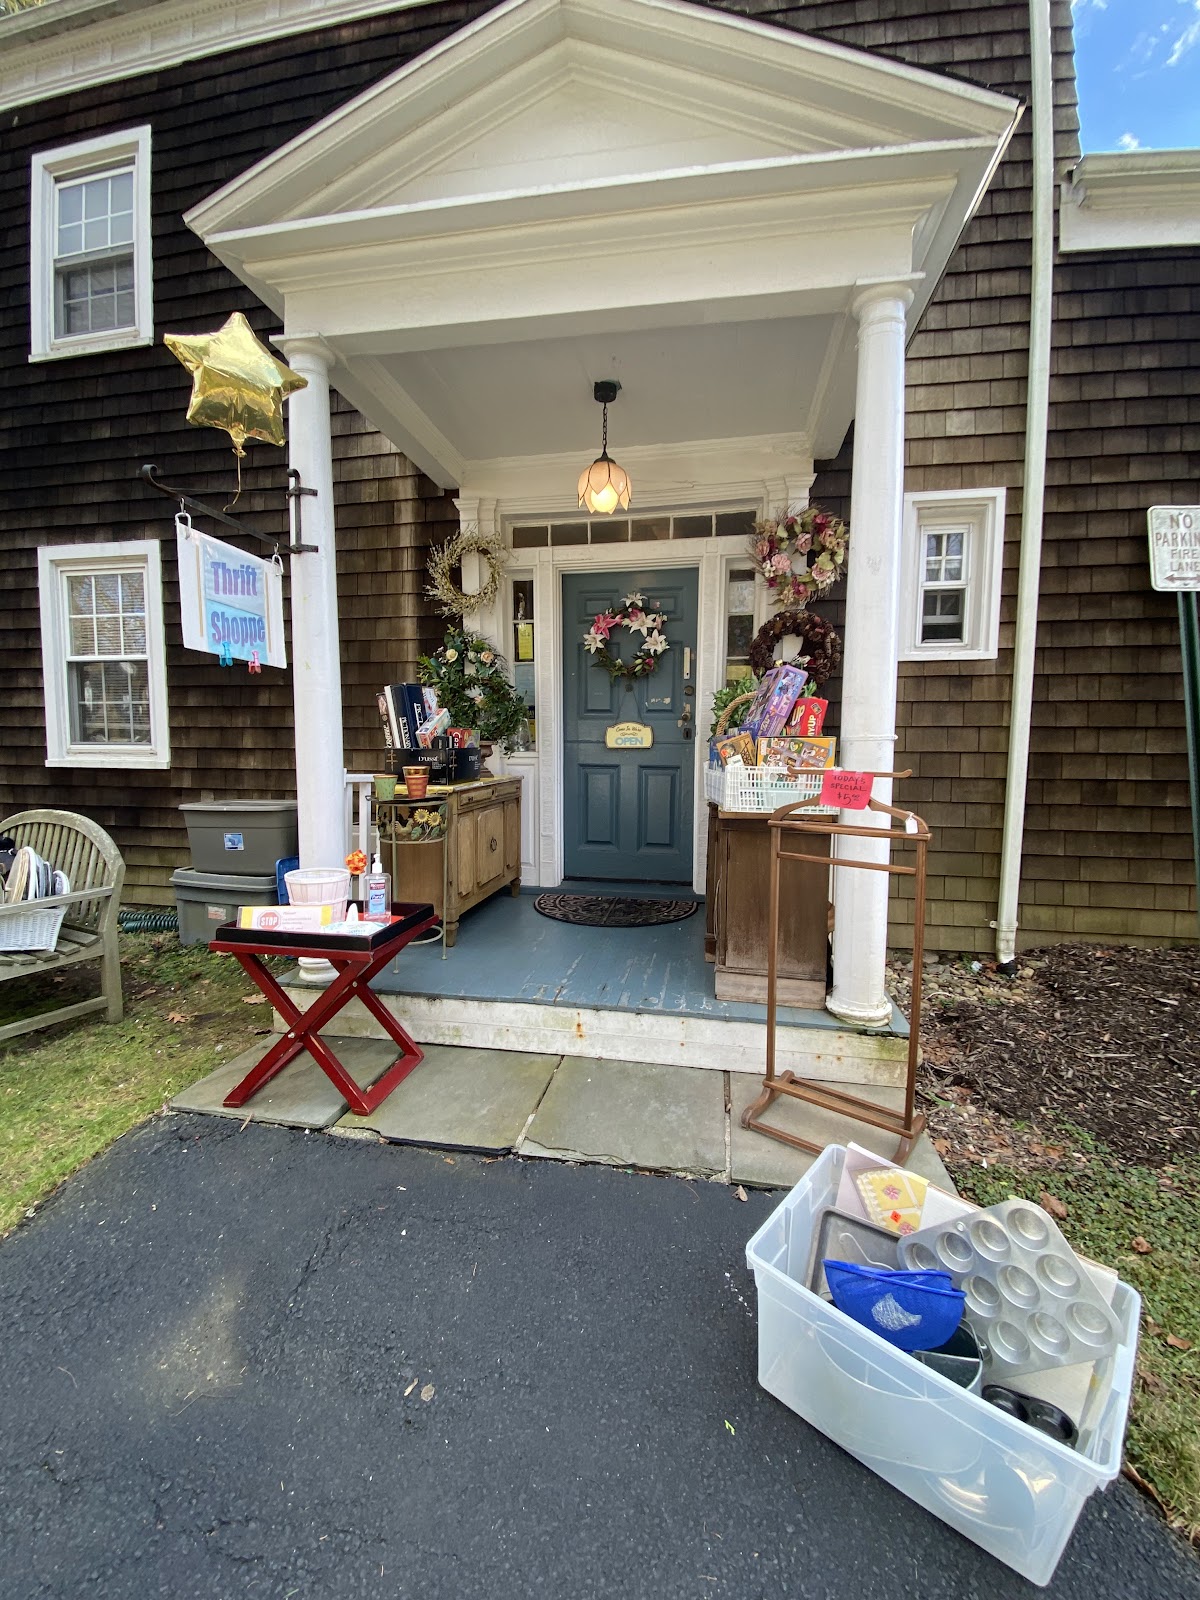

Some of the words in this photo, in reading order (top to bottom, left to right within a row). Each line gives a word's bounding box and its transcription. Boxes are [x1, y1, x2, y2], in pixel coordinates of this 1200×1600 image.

[1170, 514, 1193, 529] NO
[1155, 532, 1200, 547] PARKIN
[1170, 549, 1199, 560] FIRE
[1169, 561, 1200, 572] LANE
[211, 561, 258, 597] Thrift
[211, 611, 266, 647] Shoppe
[615, 737, 643, 745] OPEN
[830, 782, 867, 791] SPECIAL
[260, 916, 278, 926] STOP
